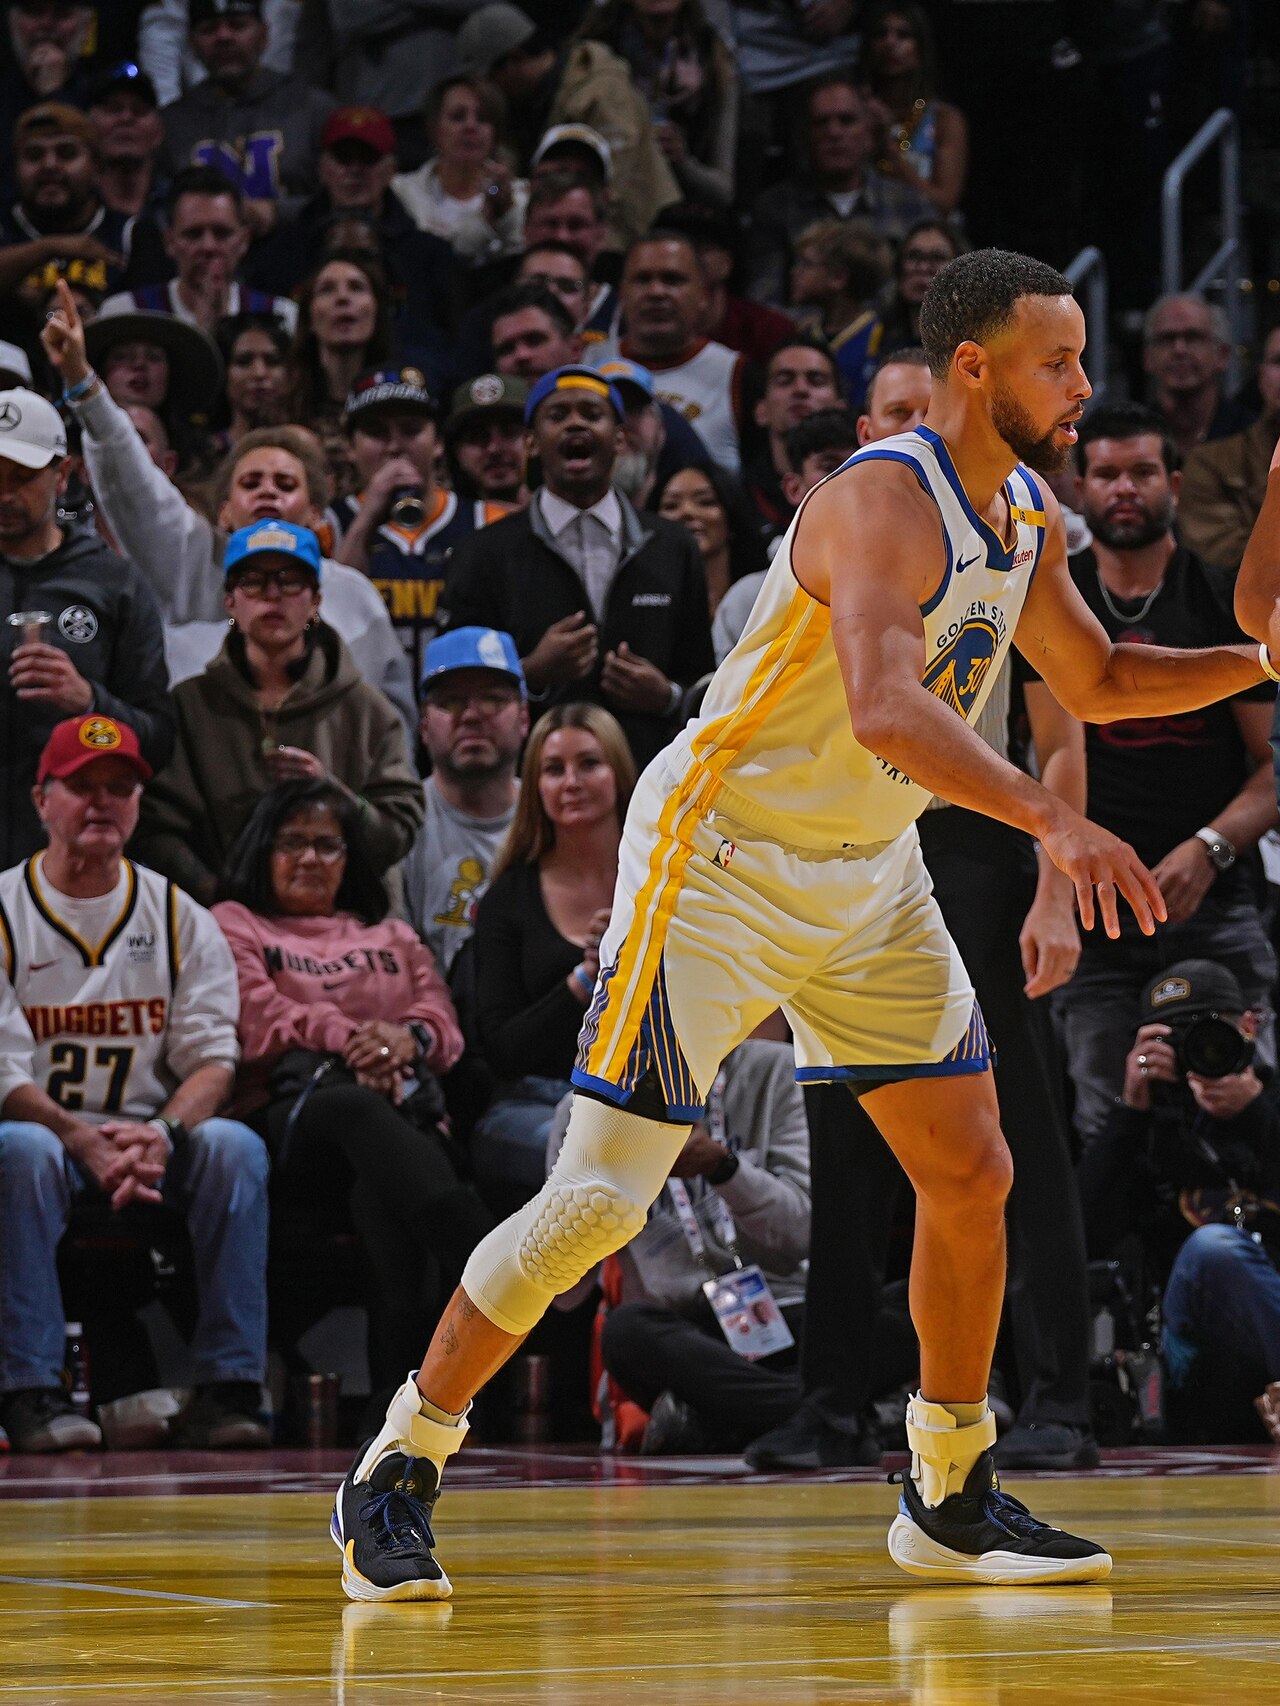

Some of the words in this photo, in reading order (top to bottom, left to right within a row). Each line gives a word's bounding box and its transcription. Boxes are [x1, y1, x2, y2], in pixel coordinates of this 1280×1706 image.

[959, 657, 991, 696] 30
[262, 944, 399, 977] NUGGETS
[23, 997, 166, 1042] NUGGETS
[47, 1041, 135, 1112] 27
